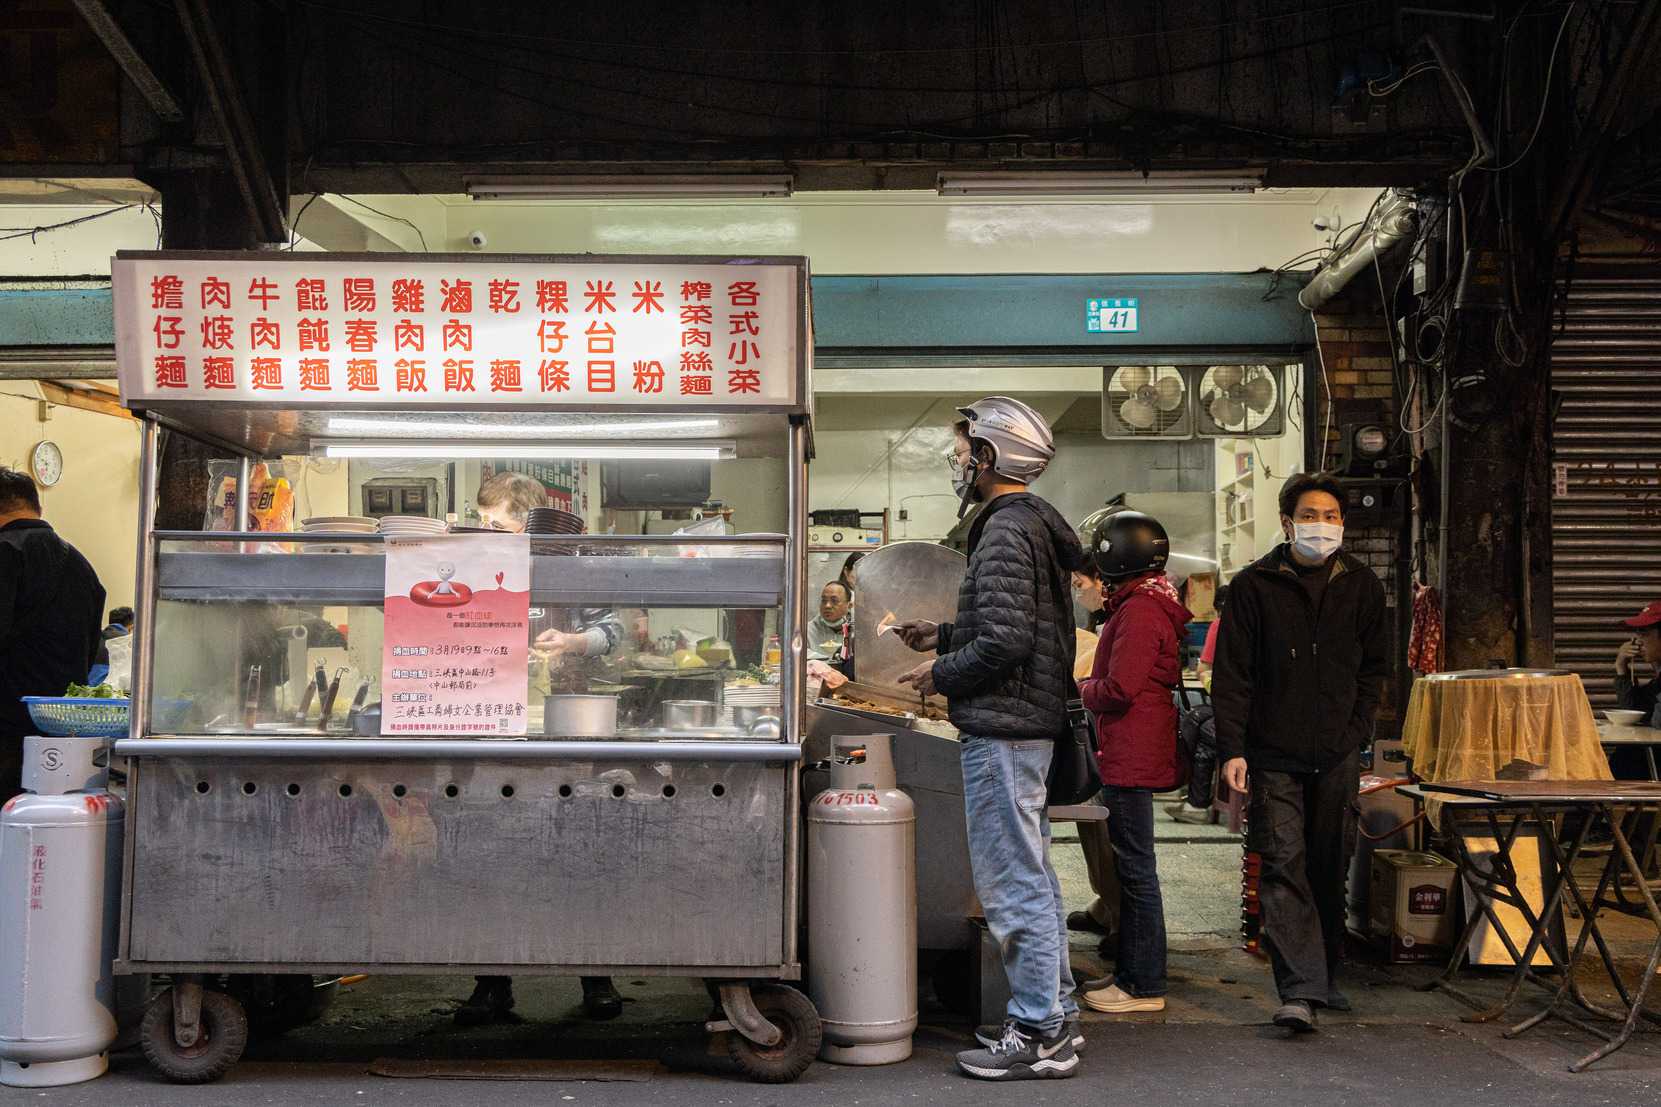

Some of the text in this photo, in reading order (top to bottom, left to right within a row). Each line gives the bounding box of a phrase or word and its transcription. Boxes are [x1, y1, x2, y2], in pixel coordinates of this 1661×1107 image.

[151, 275, 188, 388] 擔仔麵
[248, 277, 284, 390] 牛肉麵
[296, 278, 332, 391] 餛飩麵
[344, 278, 379, 391] 陽春麵
[392, 279, 427, 392] 雞肉飯
[441, 279, 475, 391] 滷肉飯
[488, 279, 522, 392] 乾麵
[536, 280, 570, 392] 粿仔條
[584, 280, 616, 392] 米台目
[632, 281, 665, 393] 米粉
[680, 281, 712, 395] 榨菜肉絲麵
[728, 282, 760, 393] 各式小菜
[1109, 311, 1128, 328] 41
